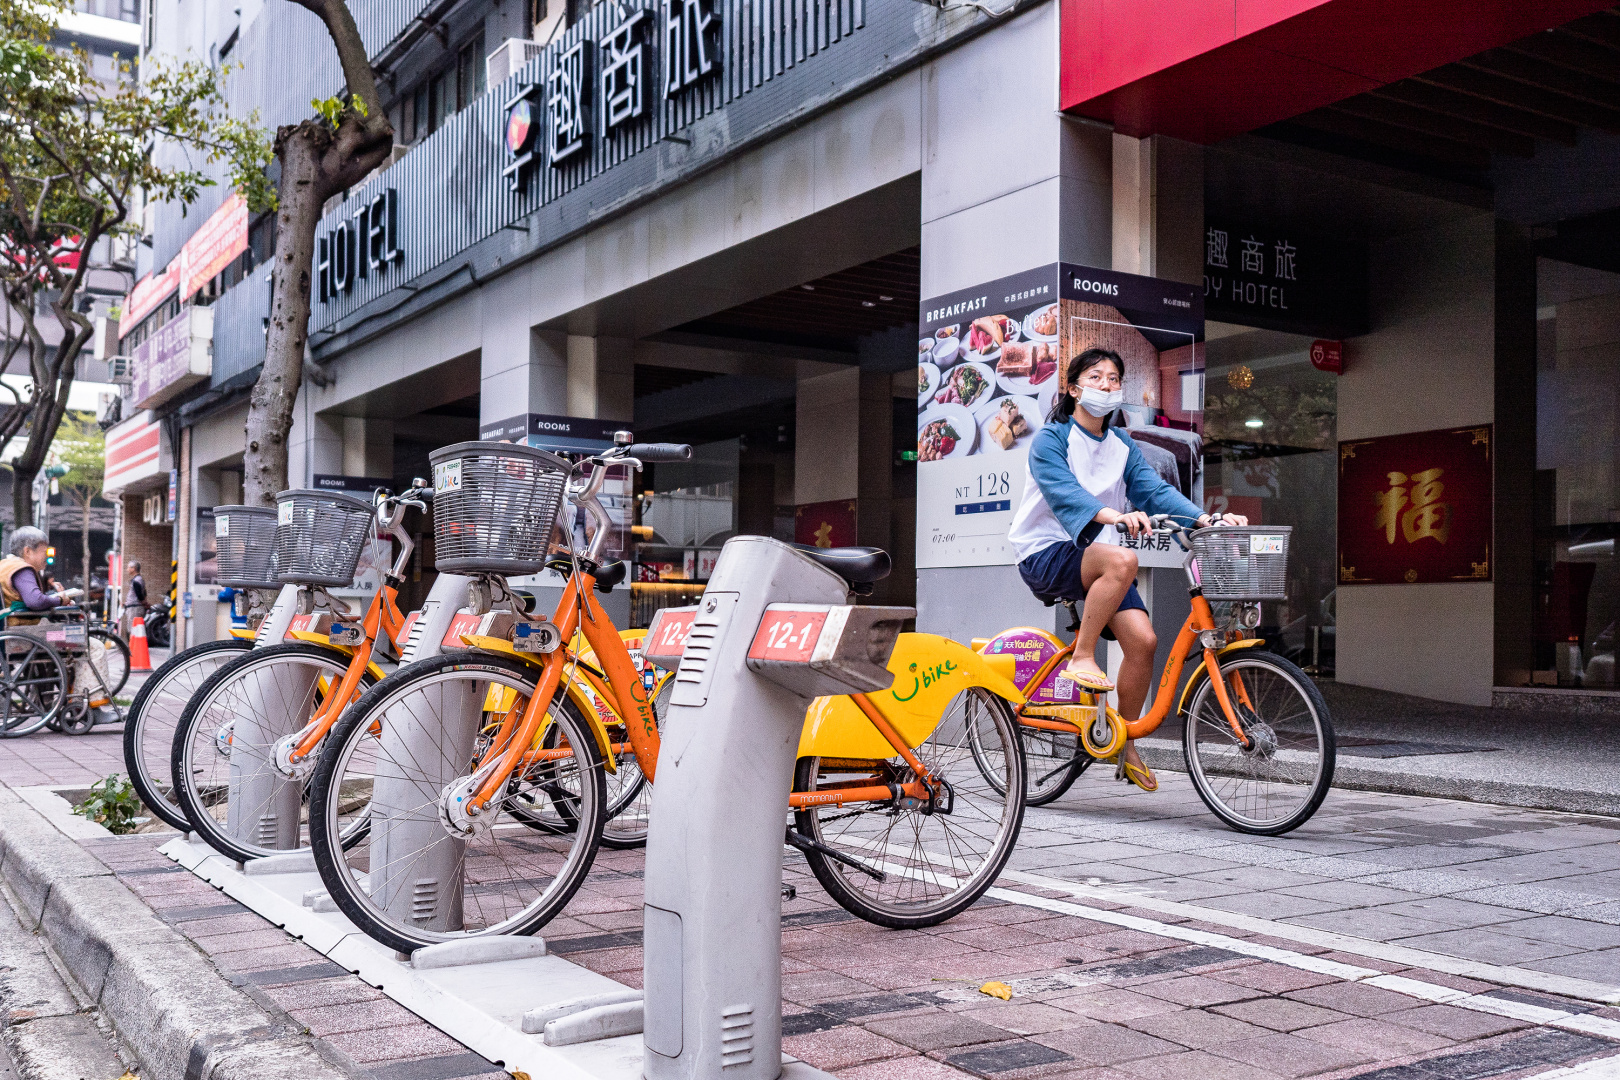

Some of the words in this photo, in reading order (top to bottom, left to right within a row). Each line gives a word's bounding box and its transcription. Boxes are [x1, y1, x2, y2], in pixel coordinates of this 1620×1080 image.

[318, 188, 400, 303] HOTEL
[1073, 278, 1119, 296] ROOMS
[1232, 280, 1288, 310] HOTEL
[926, 296, 988, 323] BREAKFAST
[538, 421, 571, 432] ROOMS
[320, 479, 346, 487] ROOMS
[955, 486, 971, 499] NT
[976, 470, 1010, 498] 128
[1374, 467, 1450, 545] 福
[932, 533, 956, 544] 07:00
[766, 621, 812, 650] 12-1
[800, 793, 843, 803] momentum
